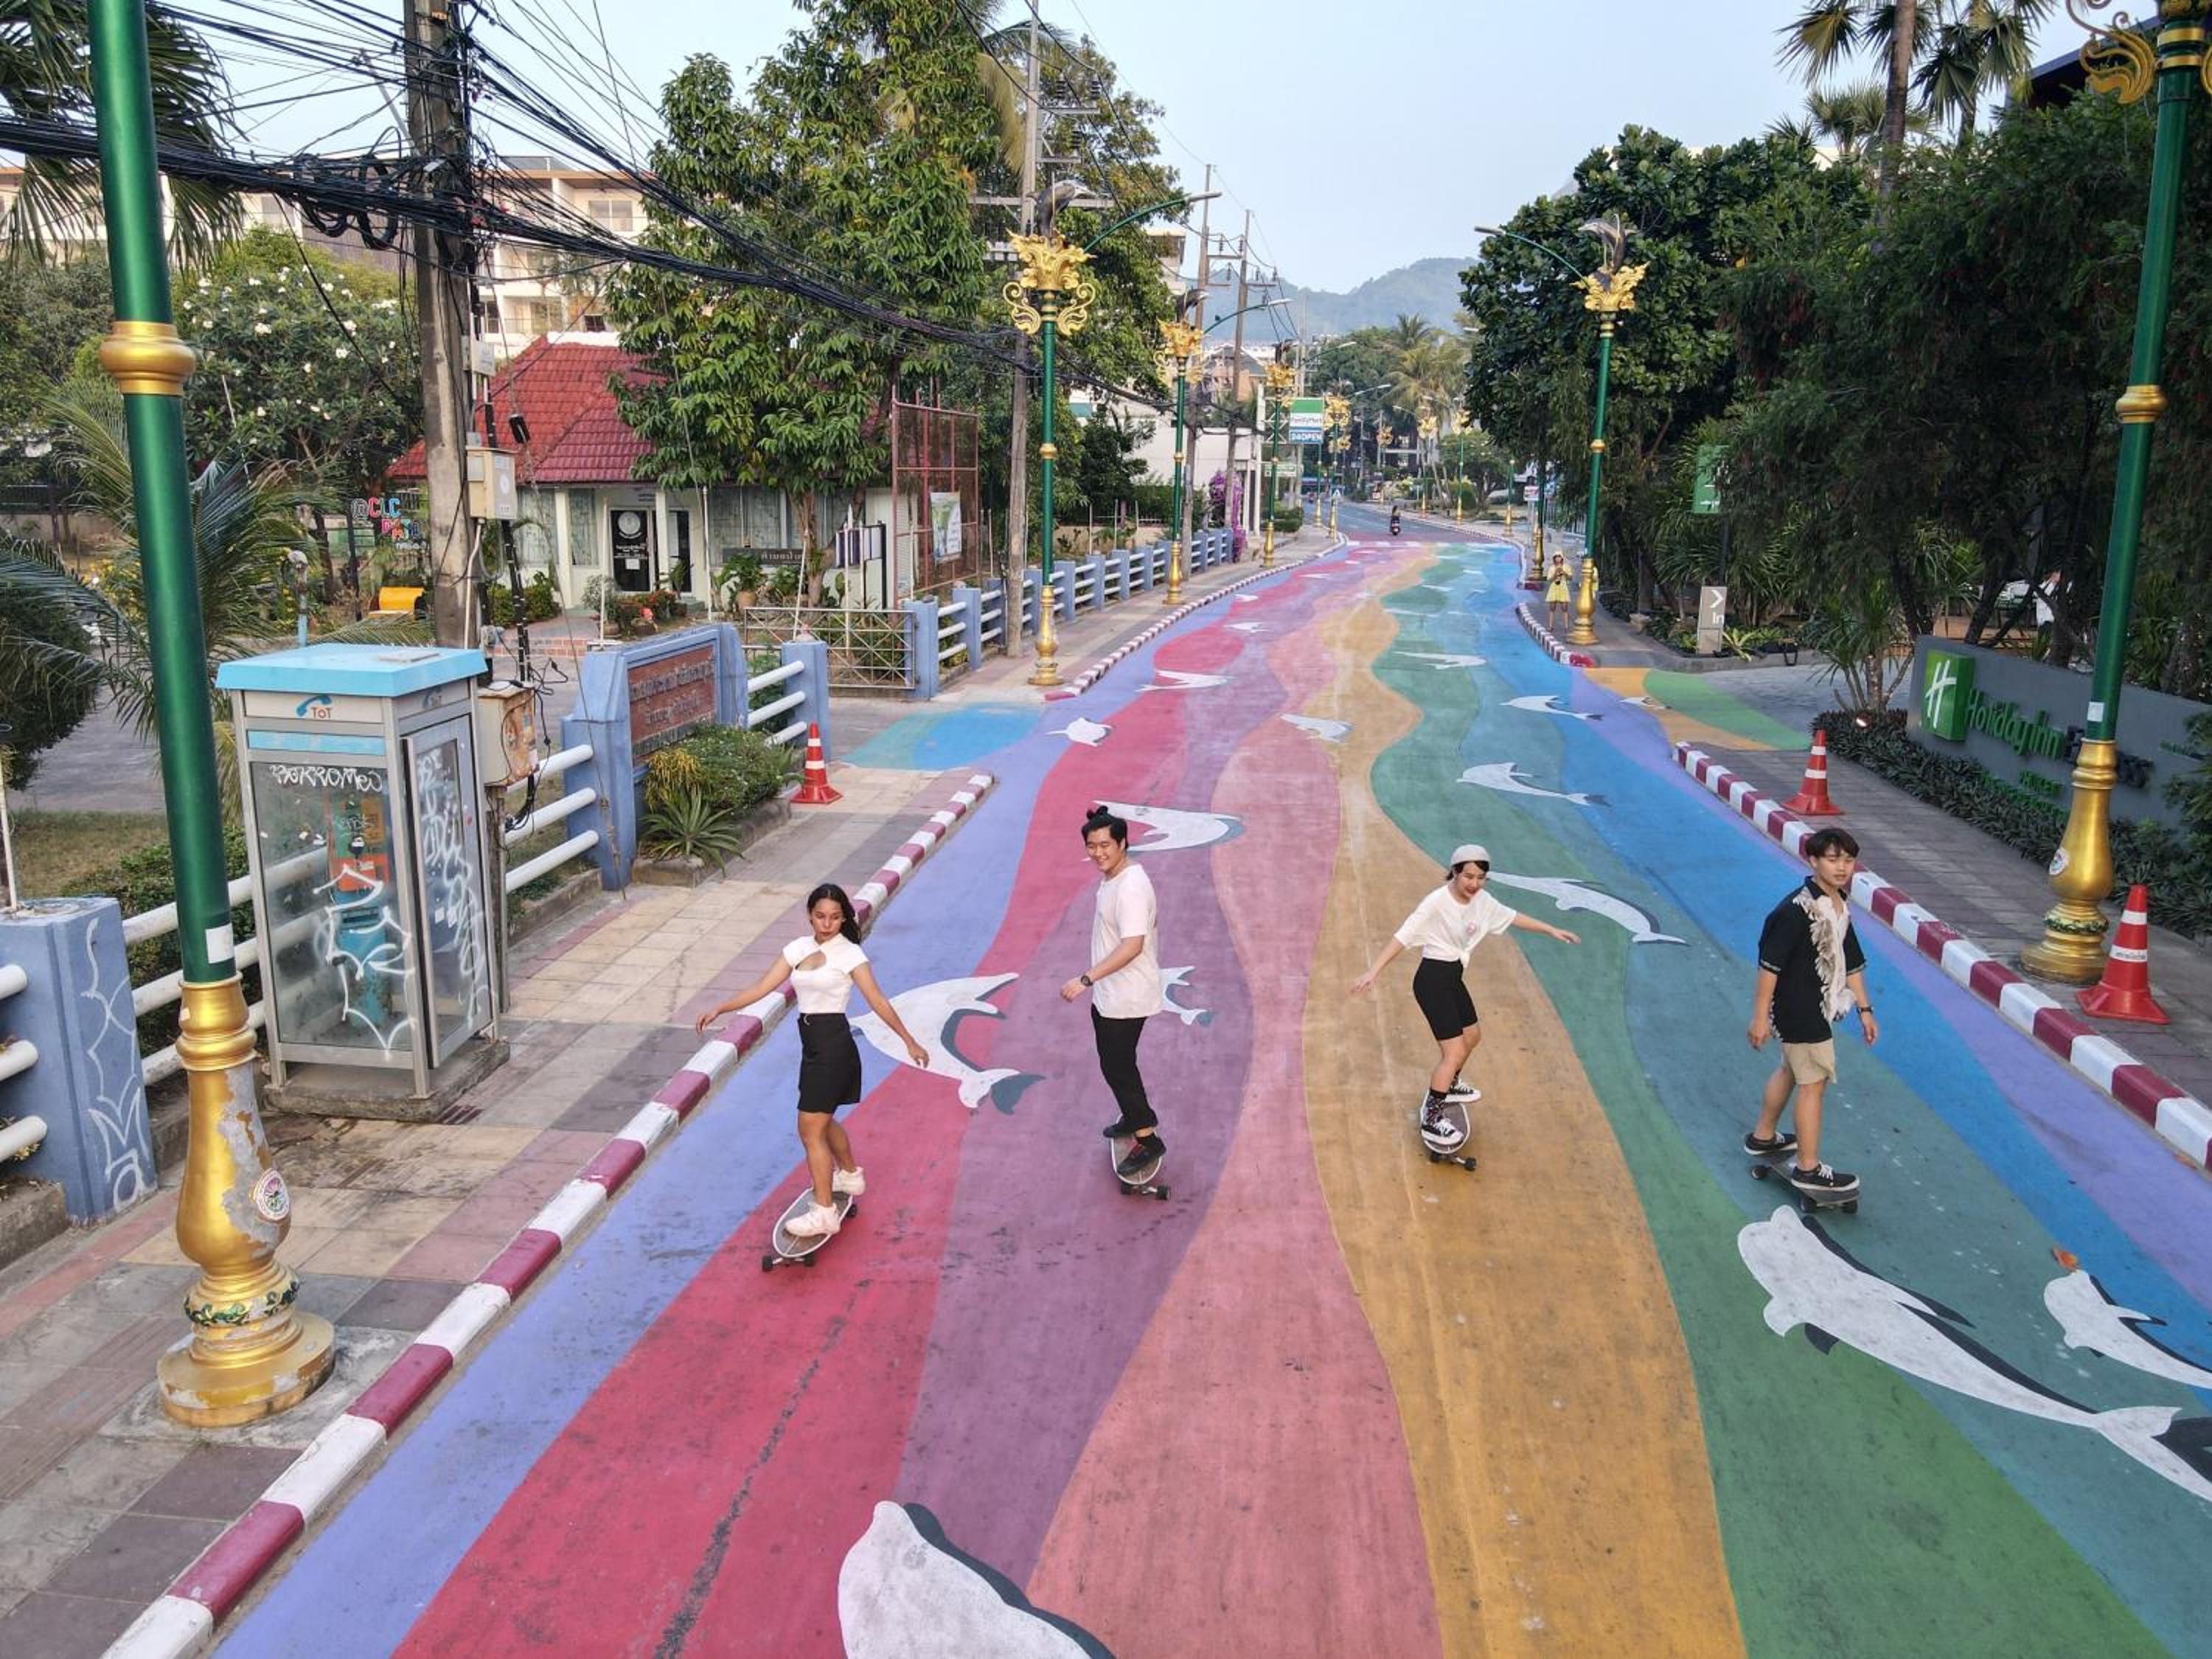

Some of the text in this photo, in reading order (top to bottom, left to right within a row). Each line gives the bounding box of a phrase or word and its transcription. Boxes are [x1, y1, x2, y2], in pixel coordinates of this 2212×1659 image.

[1713, 612, 1724, 625] In
[1966, 687, 2029, 756] Holiday
[2028, 708, 2065, 760] Inn
